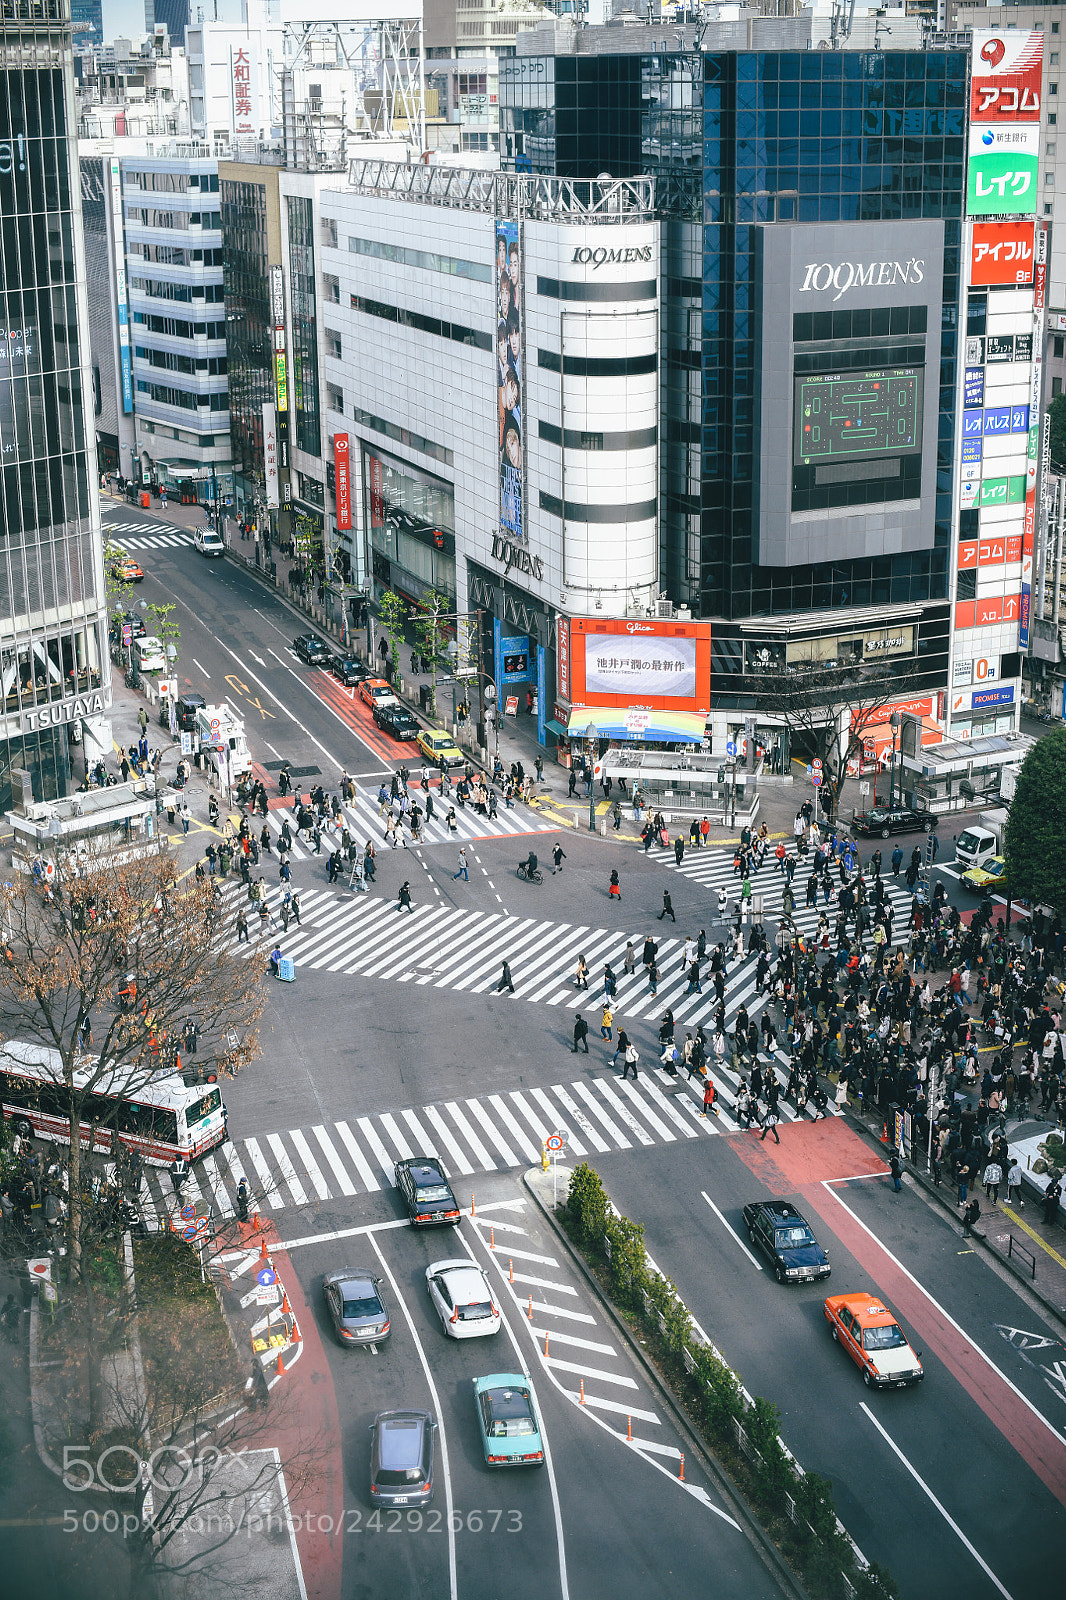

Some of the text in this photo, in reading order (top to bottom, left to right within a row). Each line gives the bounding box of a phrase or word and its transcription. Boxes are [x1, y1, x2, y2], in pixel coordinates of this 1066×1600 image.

[233, 47, 252, 117] 大和証券
[978, 86, 1040, 112] アコム
[996, 133, 1028, 143] 新生銀行
[975, 171, 1032, 197] レイク
[974, 241, 1032, 262] アイフル
[1015, 270, 1031, 282] 8F
[966, 470, 975, 478] 6F
[981, 484, 1008, 499] レイク
[1025, 506, 1034, 535] アコム
[963, 544, 1004, 562] アコム
[981, 611, 997, 622] 入口
[1021, 593, 1031, 630] PROMISE
[625, 622, 655, 634] Glico
[596, 657, 686, 672] 池井戸潤の最新作
[974, 692, 1000, 704] PROMISE
[27, 695, 103, 731] TSUTAYA
